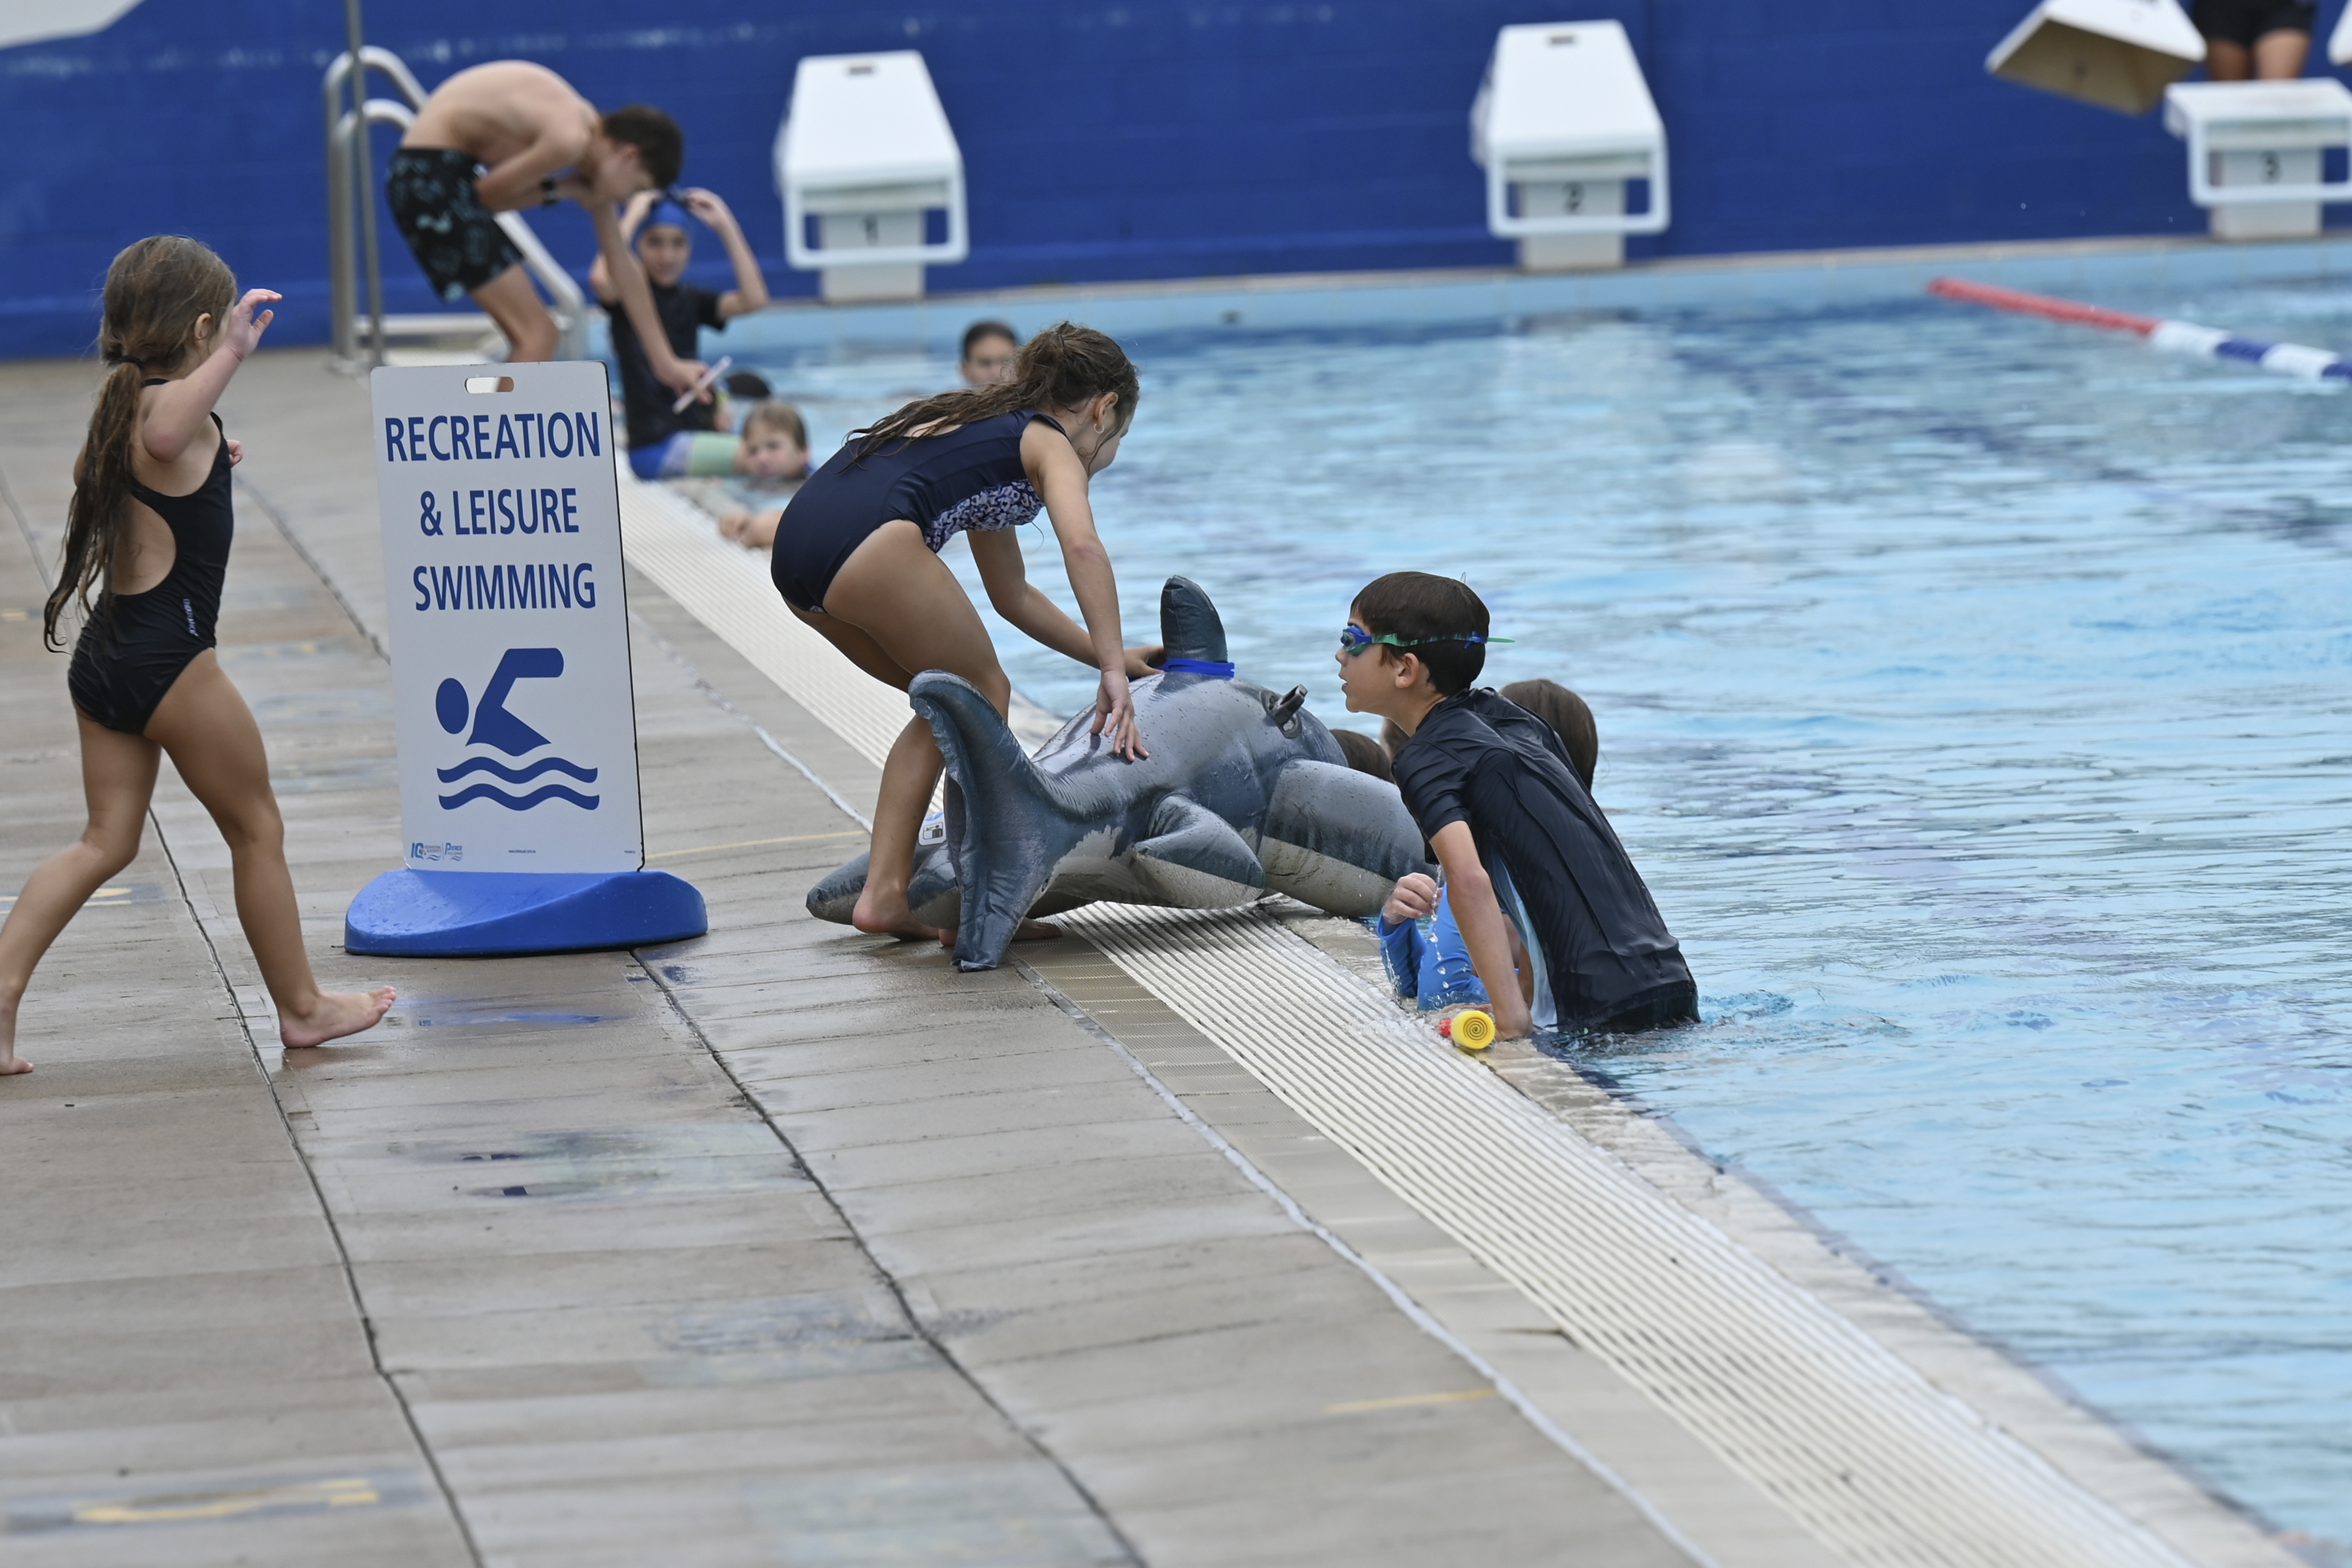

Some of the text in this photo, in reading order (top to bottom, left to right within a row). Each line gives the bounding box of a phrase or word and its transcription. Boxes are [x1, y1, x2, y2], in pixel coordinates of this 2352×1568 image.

[385, 412, 601, 462] RECREATION
[420, 487, 579, 536] & LEISURE
[413, 563, 596, 611] SWIMMING
